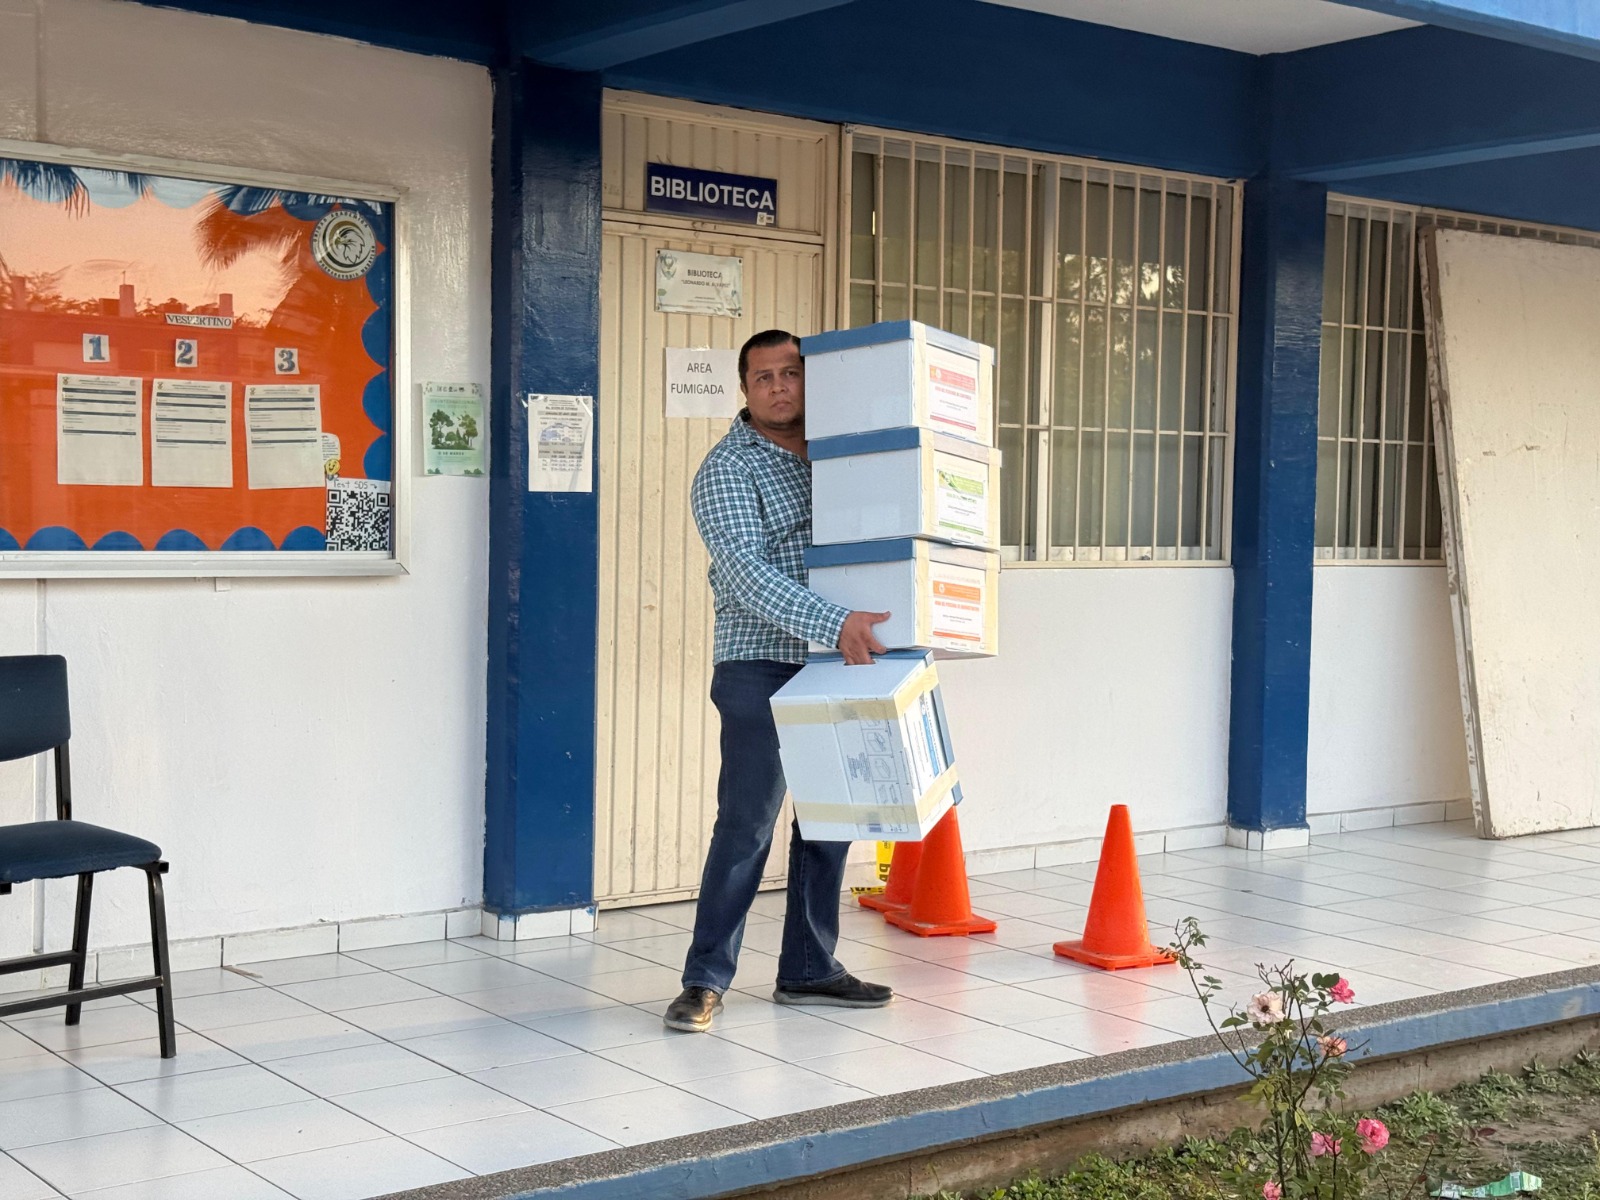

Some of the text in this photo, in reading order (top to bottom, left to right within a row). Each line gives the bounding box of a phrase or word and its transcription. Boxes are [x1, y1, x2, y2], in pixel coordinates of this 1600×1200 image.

[651, 175, 774, 211] BIBLIOTECA
[687, 269, 723, 279] BIBLIOTECA
[167, 314, 232, 327] VESPERTINO
[88, 335, 106, 361] 1
[177, 340, 194, 365] 2
[277, 349, 296, 373] 3
[686, 362, 713, 374] AREA
[670, 383, 725, 395] FUMIGADA
